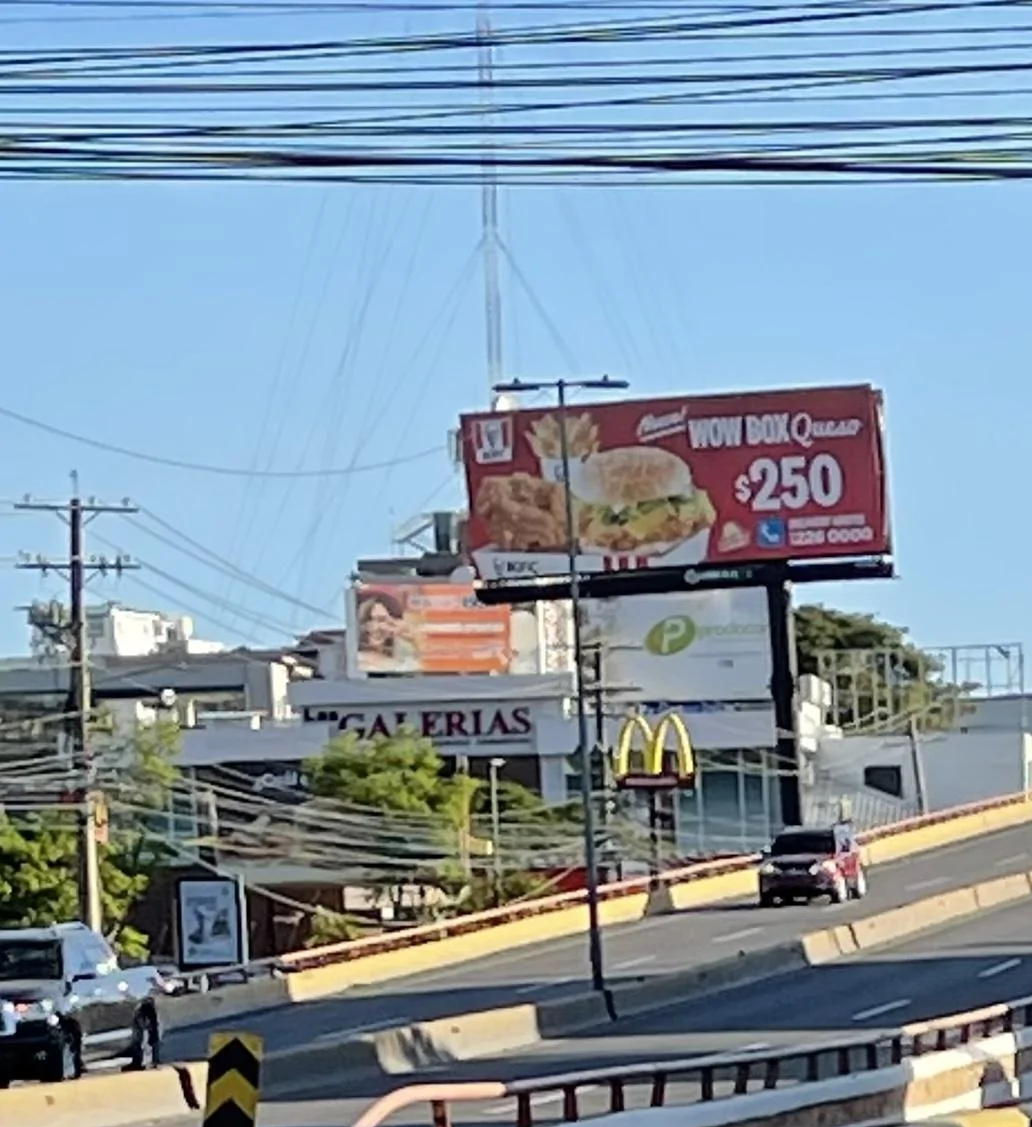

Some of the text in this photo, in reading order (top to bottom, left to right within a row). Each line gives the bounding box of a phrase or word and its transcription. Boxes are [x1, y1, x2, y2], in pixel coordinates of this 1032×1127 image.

[688, 416, 743, 449] WOW
[746, 413, 792, 446] BOX
[734, 453, 844, 512] $250
